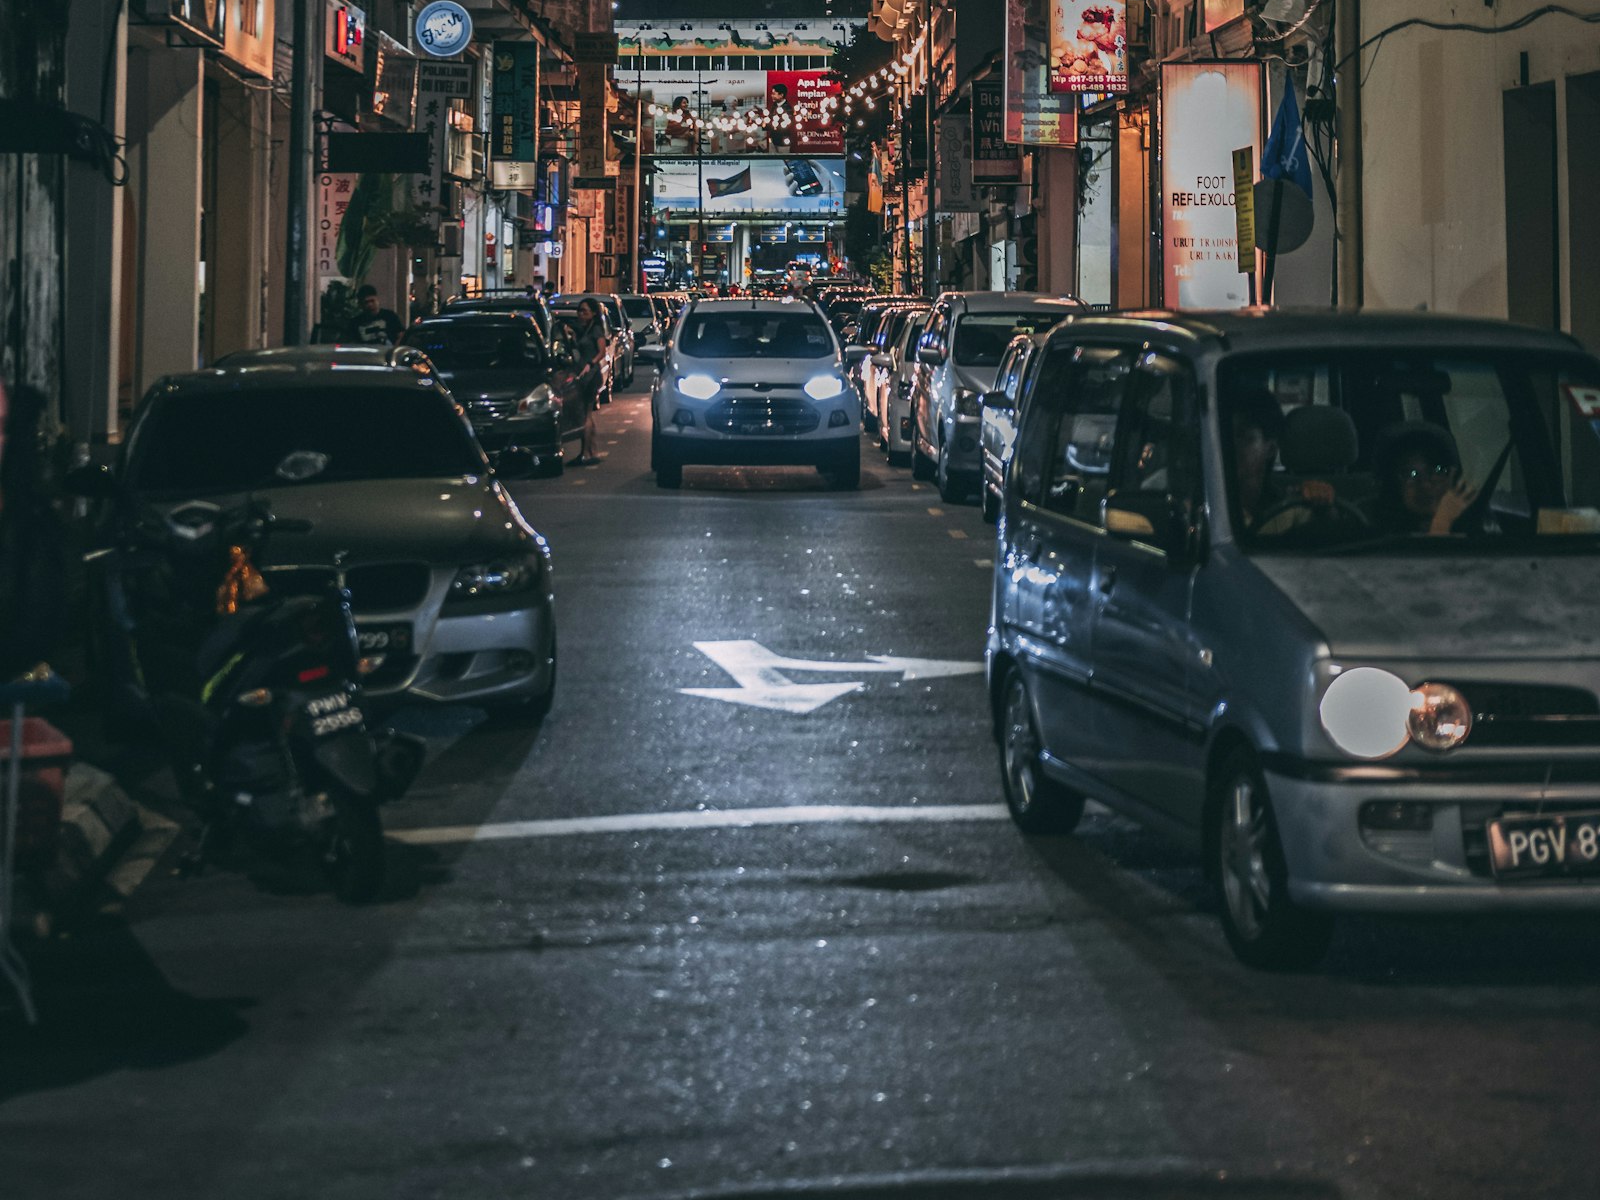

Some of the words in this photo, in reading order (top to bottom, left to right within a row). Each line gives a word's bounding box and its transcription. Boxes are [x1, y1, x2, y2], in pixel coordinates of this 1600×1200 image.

[797, 78, 816, 88] Apa
[816, 78, 831, 88] jua
[1053, 75, 1066, 84] H/p
[1071, 83, 1104, 92] 016-489
[1106, 83, 1128, 92] 1832
[980, 93, 1001, 106] Bla
[980, 119, 1001, 133] Wh
[1196, 176, 1227, 189] FOOT
[1172, 192, 1236, 207] REFLEXOLO
[1173, 238, 1196, 248] URUT
[1200, 238, 1238, 248] TRADISIO
[1189, 251, 1211, 261] URUT
[1509, 826, 1567, 867] PGV
[1577, 822, 1600, 862] 8
